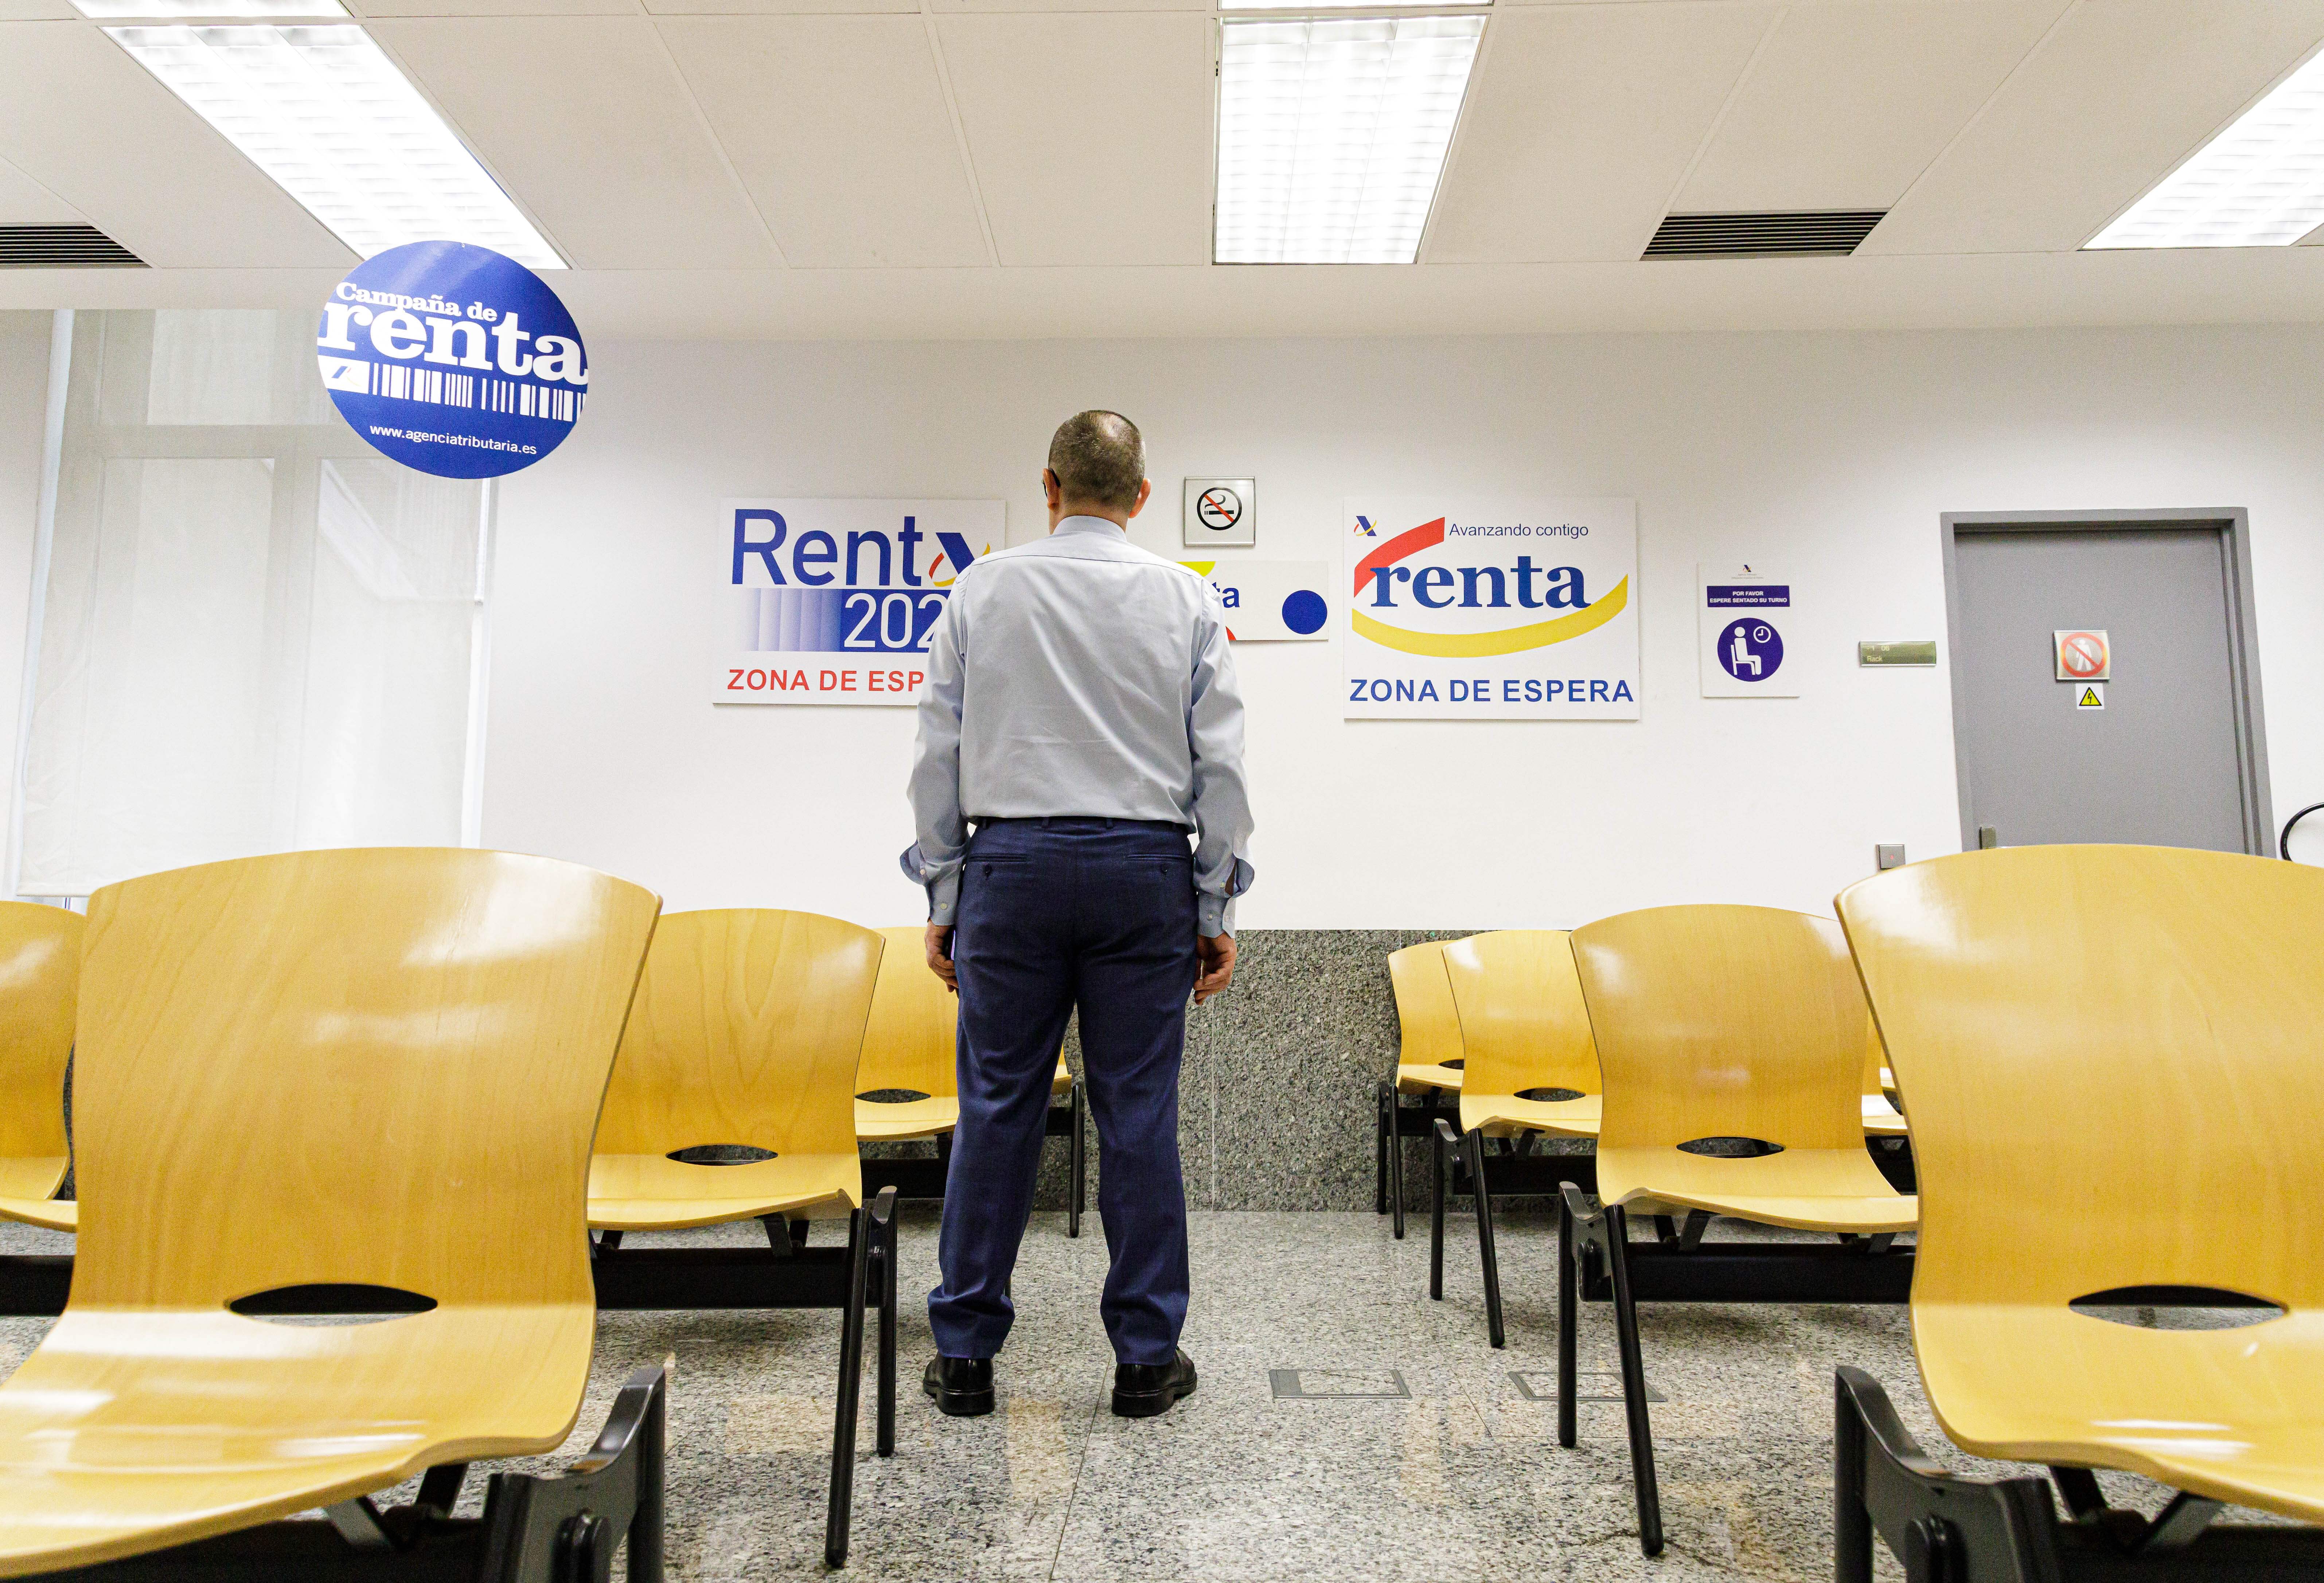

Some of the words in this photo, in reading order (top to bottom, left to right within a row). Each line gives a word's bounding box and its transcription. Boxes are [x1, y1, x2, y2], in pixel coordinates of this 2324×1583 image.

[336, 282, 462, 317] Campaña
[467, 301, 498, 322] de
[317, 302, 588, 385] renta
[370, 425, 537, 455] www.agenciatributaria.es
[1449, 523, 1531, 536] Avanzando
[1536, 523, 1588, 539] contigo
[1370, 556, 1591, 609] renta
[844, 593, 948, 648] 202
[727, 669, 810, 691] ZONA
[820, 670, 857, 691] DE
[869, 671, 924, 692] ESP
[1350, 679, 1439, 701] ZONA
[1450, 680, 1490, 701] DE
[1504, 680, 1634, 702] ESPERA
